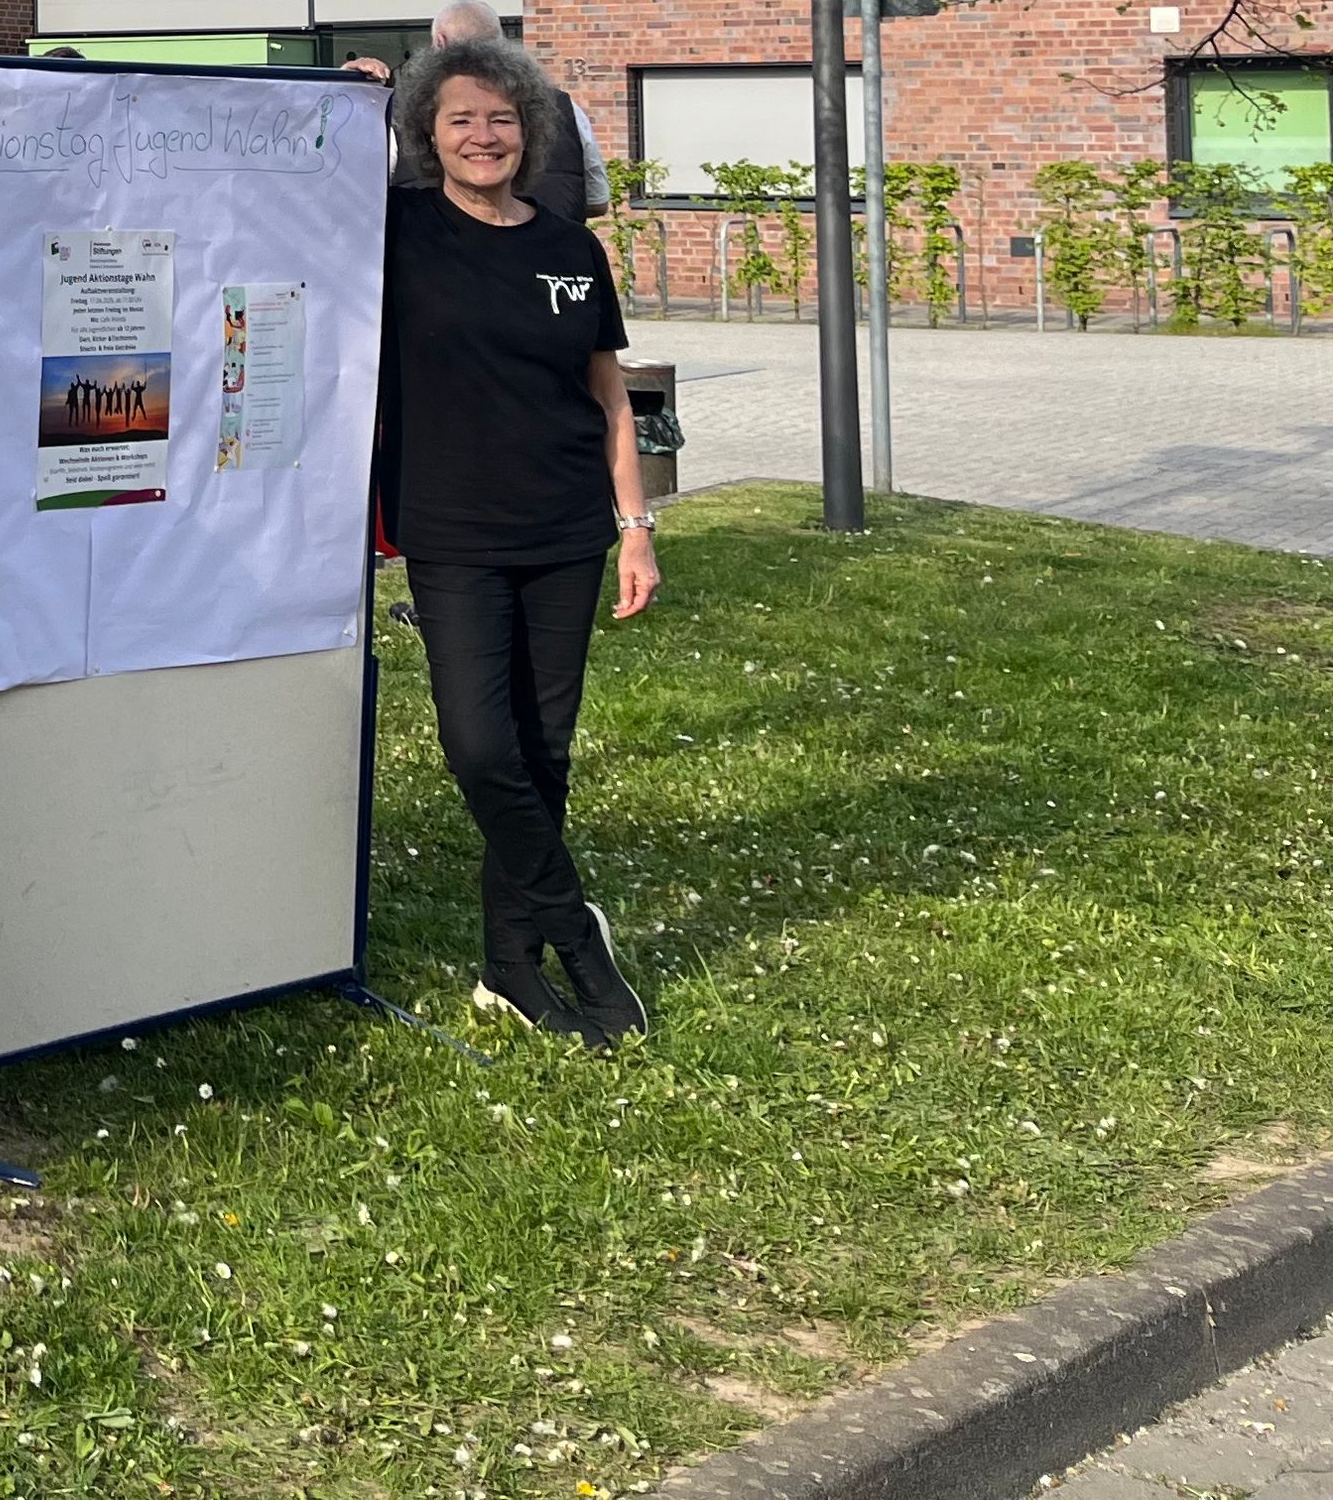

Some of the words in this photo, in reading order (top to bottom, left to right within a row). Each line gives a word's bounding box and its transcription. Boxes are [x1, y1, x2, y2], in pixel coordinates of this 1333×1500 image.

[112, 94, 213, 184] Jugend
[60, 273, 88, 285] Jugend
[89, 273, 133, 284] Aktionstage
[135, 273, 156, 281] Wahn
